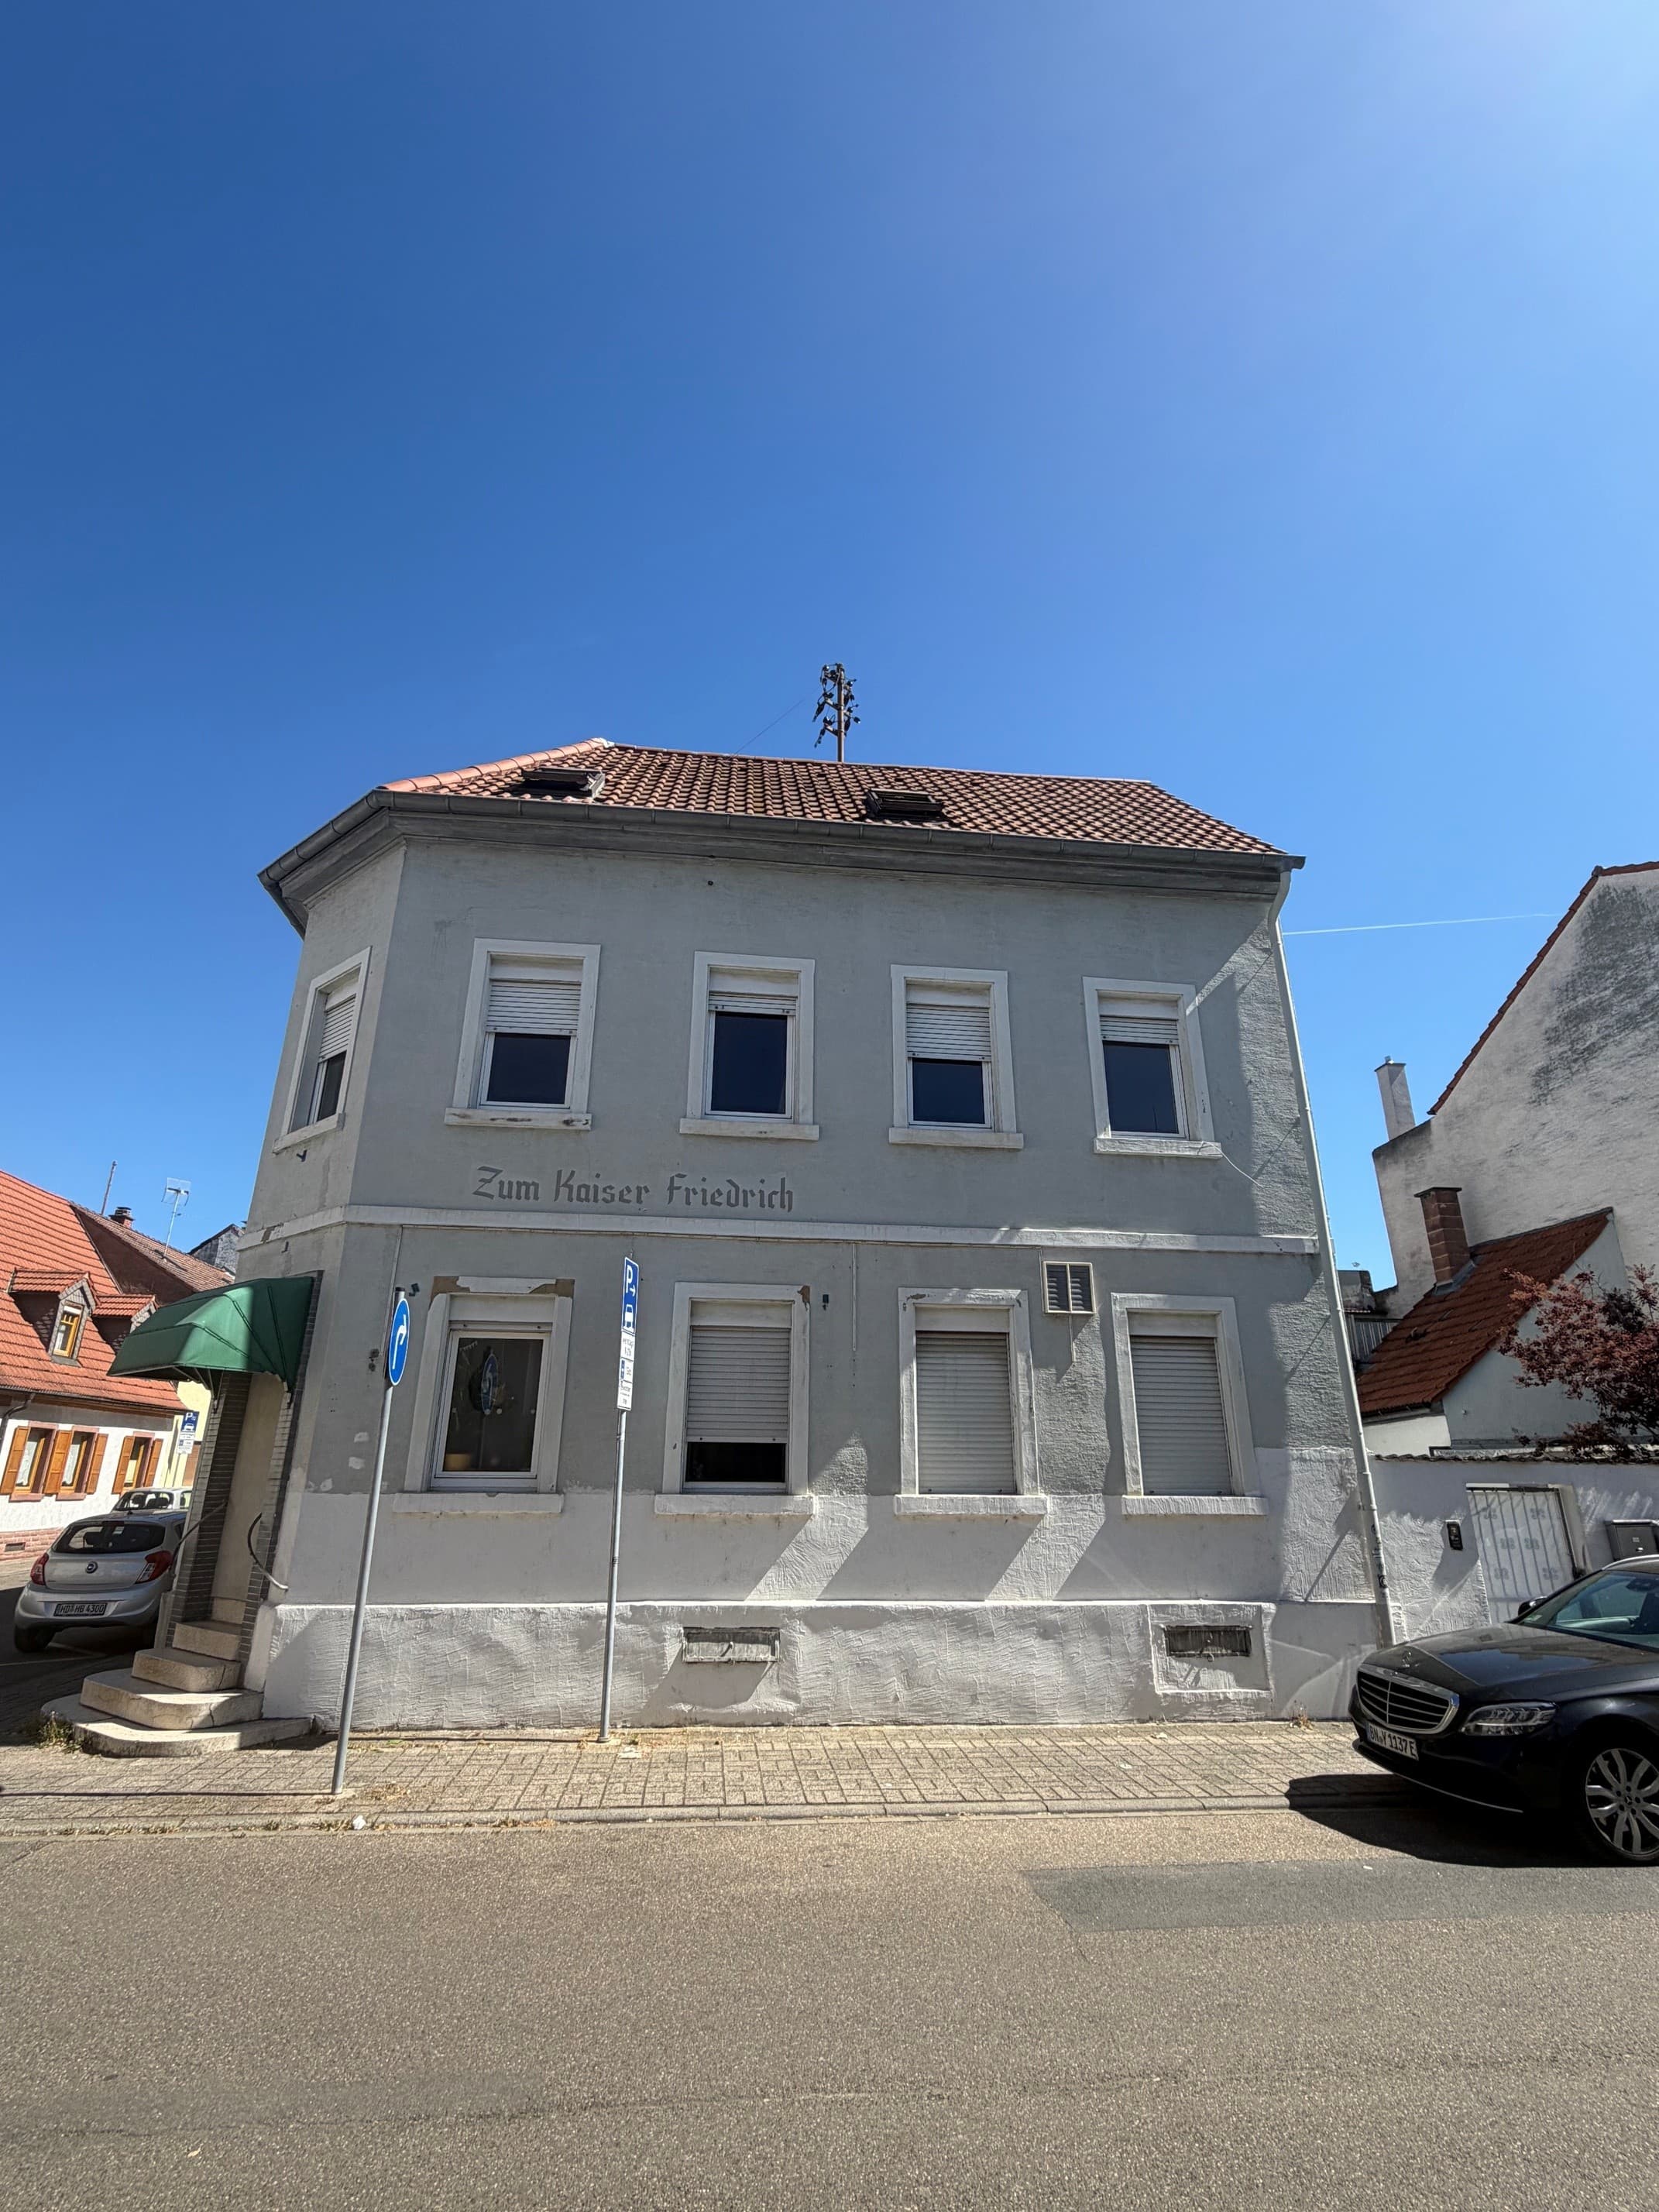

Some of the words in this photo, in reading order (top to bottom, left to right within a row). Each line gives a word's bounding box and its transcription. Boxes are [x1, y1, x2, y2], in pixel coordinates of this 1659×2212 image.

[472, 1166, 540, 1200] Zum
[554, 1170, 650, 1204] Kaiser
[667, 1173, 793, 1213] Friedrich
[626, 1265, 633, 1293] P
[185, 1412, 193, 1420] P
